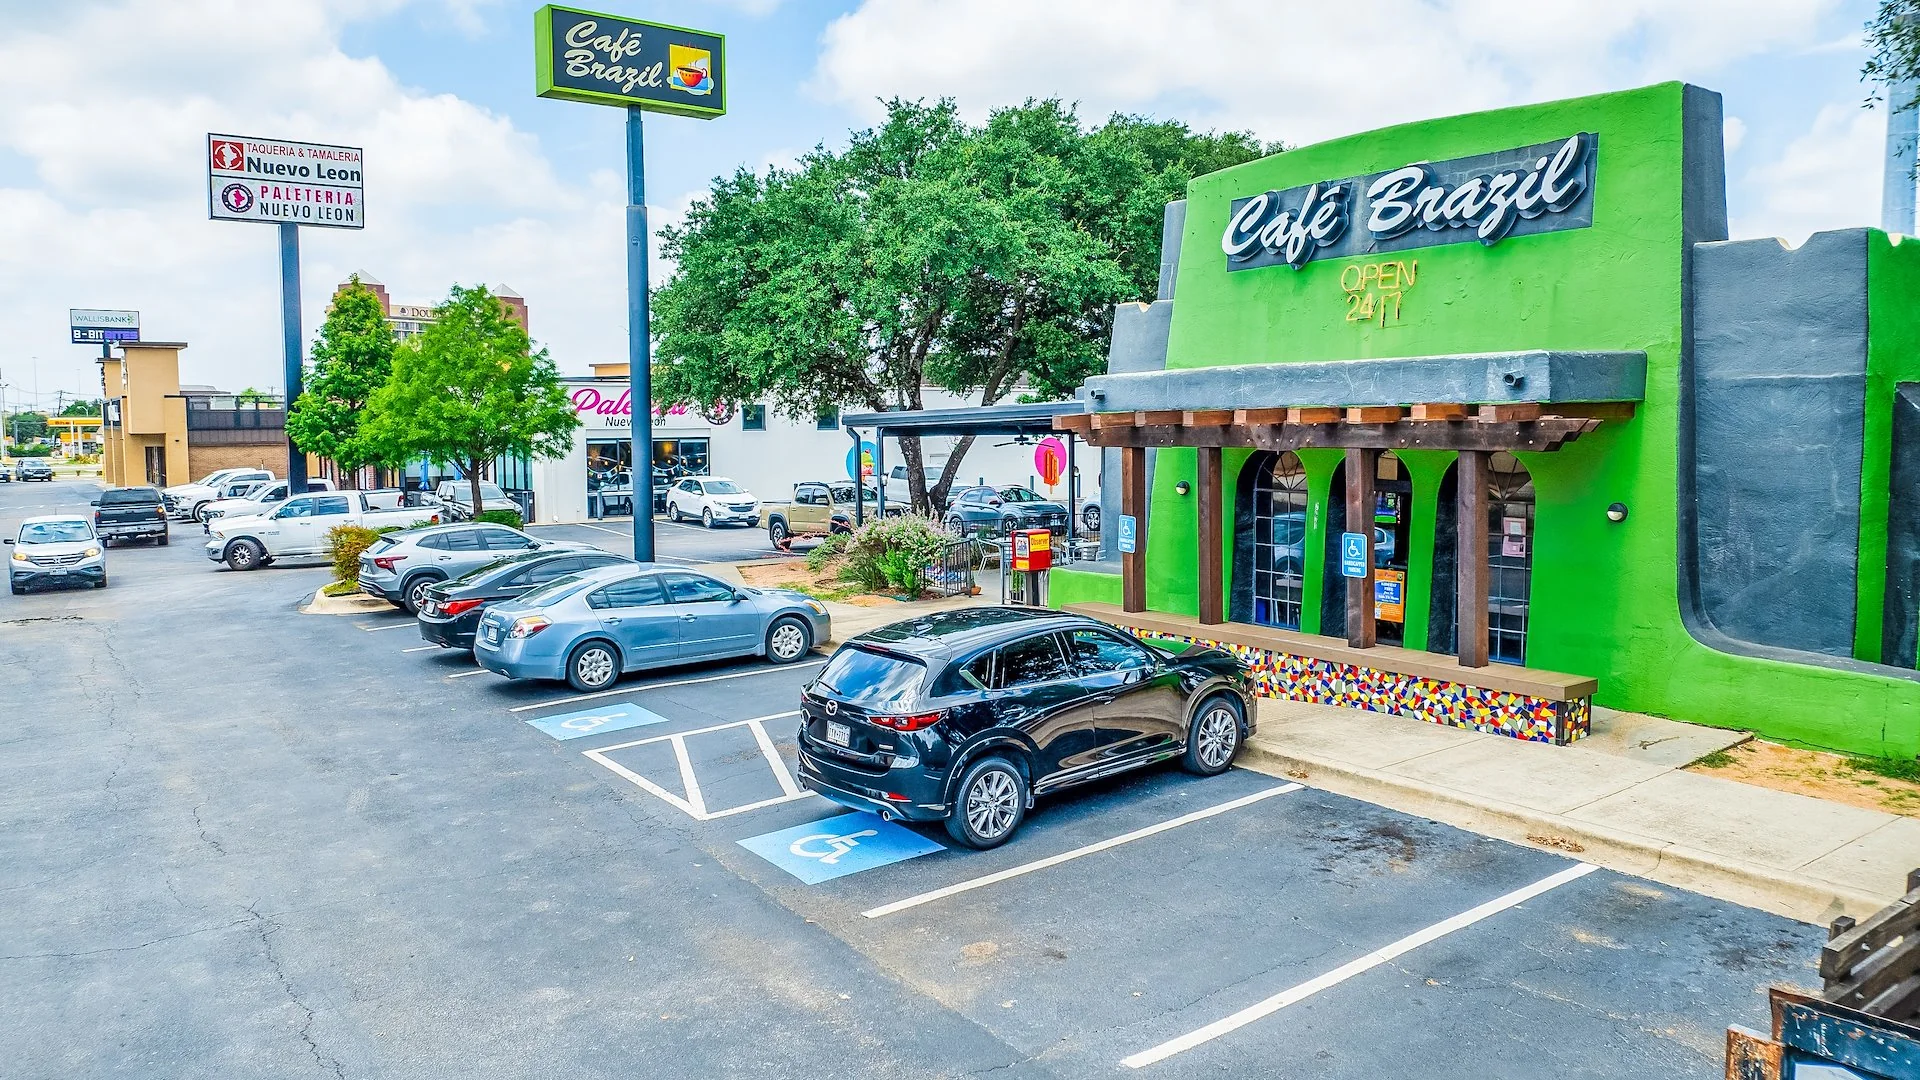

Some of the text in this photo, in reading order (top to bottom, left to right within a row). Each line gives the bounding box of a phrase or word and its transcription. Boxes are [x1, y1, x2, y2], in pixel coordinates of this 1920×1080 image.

[565, 20, 643, 63] Café
[564, 49, 663, 94] Brazil
[246, 142, 360, 163] TAQUERIA & TAMALERIA
[246, 156, 361, 182] Nuevo Leon
[260, 185, 353, 206] PALETERIA
[1221, 133, 1583, 266] Café Brazil
[260, 202, 354, 222] NUEVO LEON
[1341, 260, 1418, 292] OPEN
[74, 315, 127, 323] WALLISBANK
